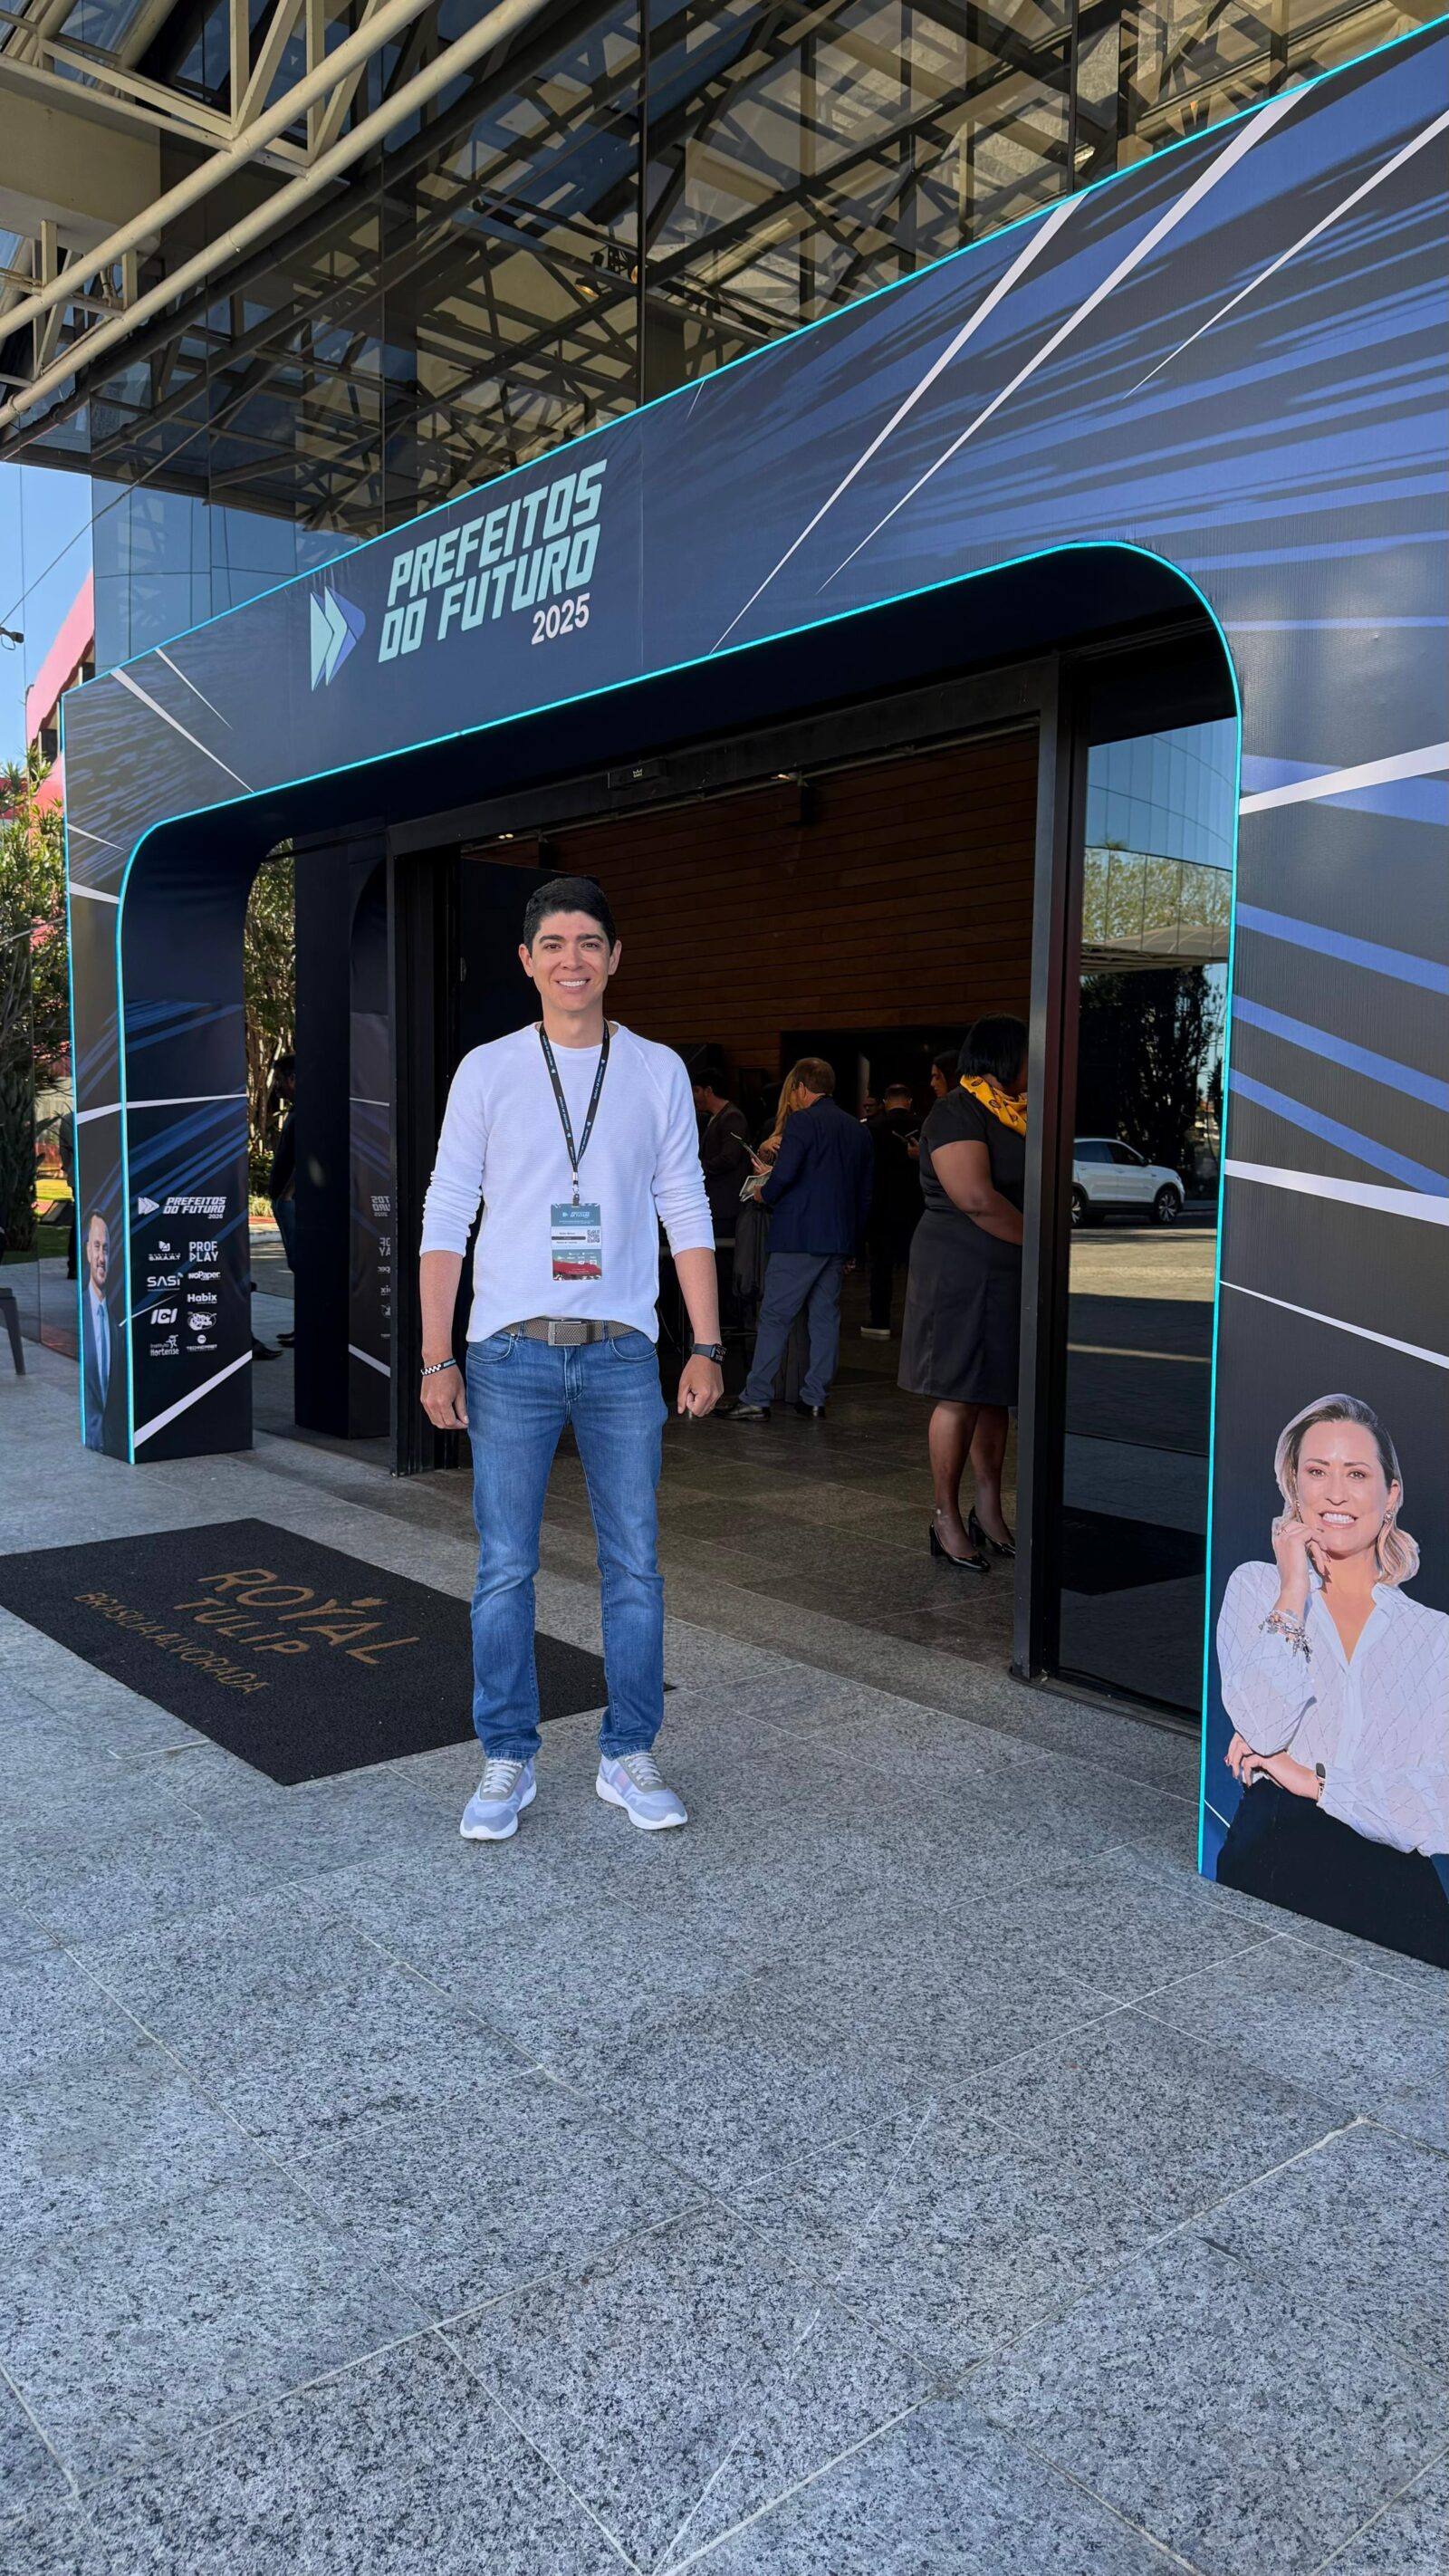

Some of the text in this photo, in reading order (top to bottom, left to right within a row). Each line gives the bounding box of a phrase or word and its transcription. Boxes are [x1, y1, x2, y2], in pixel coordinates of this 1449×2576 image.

[388, 459, 608, 608] PREFEITOS
[379, 524, 600, 663] DO FUTURO
[532, 592, 590, 645] 2025
[163, 1205, 226, 1215] DO FUTURO
[166, 1197, 227, 1206] PREFEITOS
[188, 1241, 218, 1252] PROF
[150, 1308, 178, 1325] ICI
[187, 1293, 217, 1302] Habix
[173, 1597, 311, 1655] TULIP
[197, 1568, 421, 1664] ROYAL
[145, 1633, 270, 1695] ALVORADA
